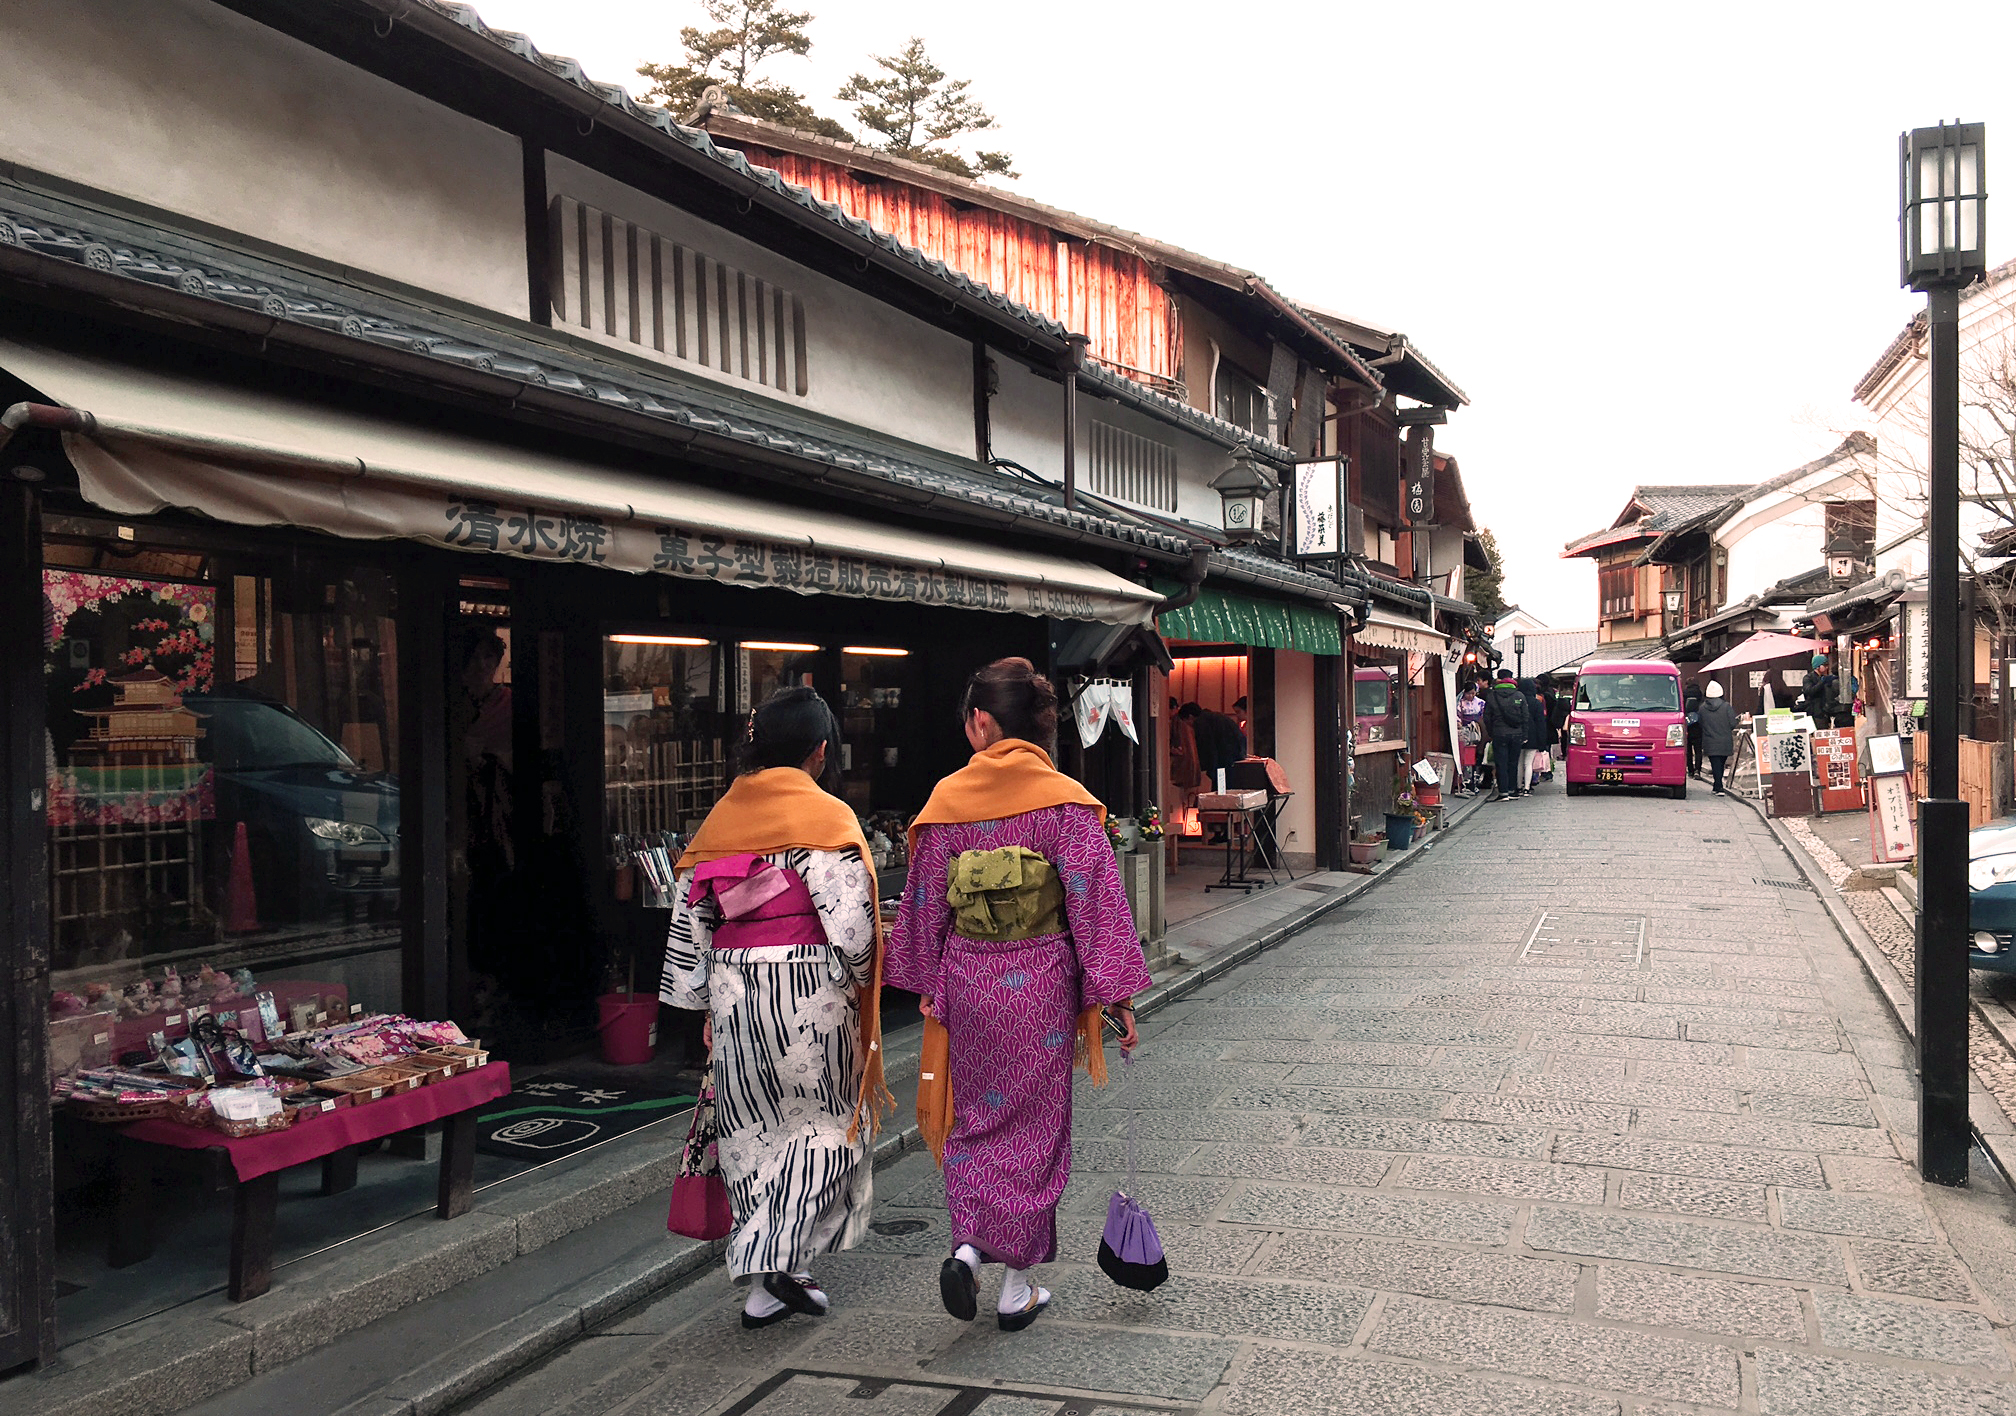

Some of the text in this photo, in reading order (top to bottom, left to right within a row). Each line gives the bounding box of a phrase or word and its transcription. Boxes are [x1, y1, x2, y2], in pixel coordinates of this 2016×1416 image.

[444, 493, 608, 563] 清水焼
[1024, 586, 1046, 611] TEL
[1047, 590, 1094, 616] 561-6316
[1448, 648, 1462, 664] 甘
[1601, 772, 1623, 781] 78-32
